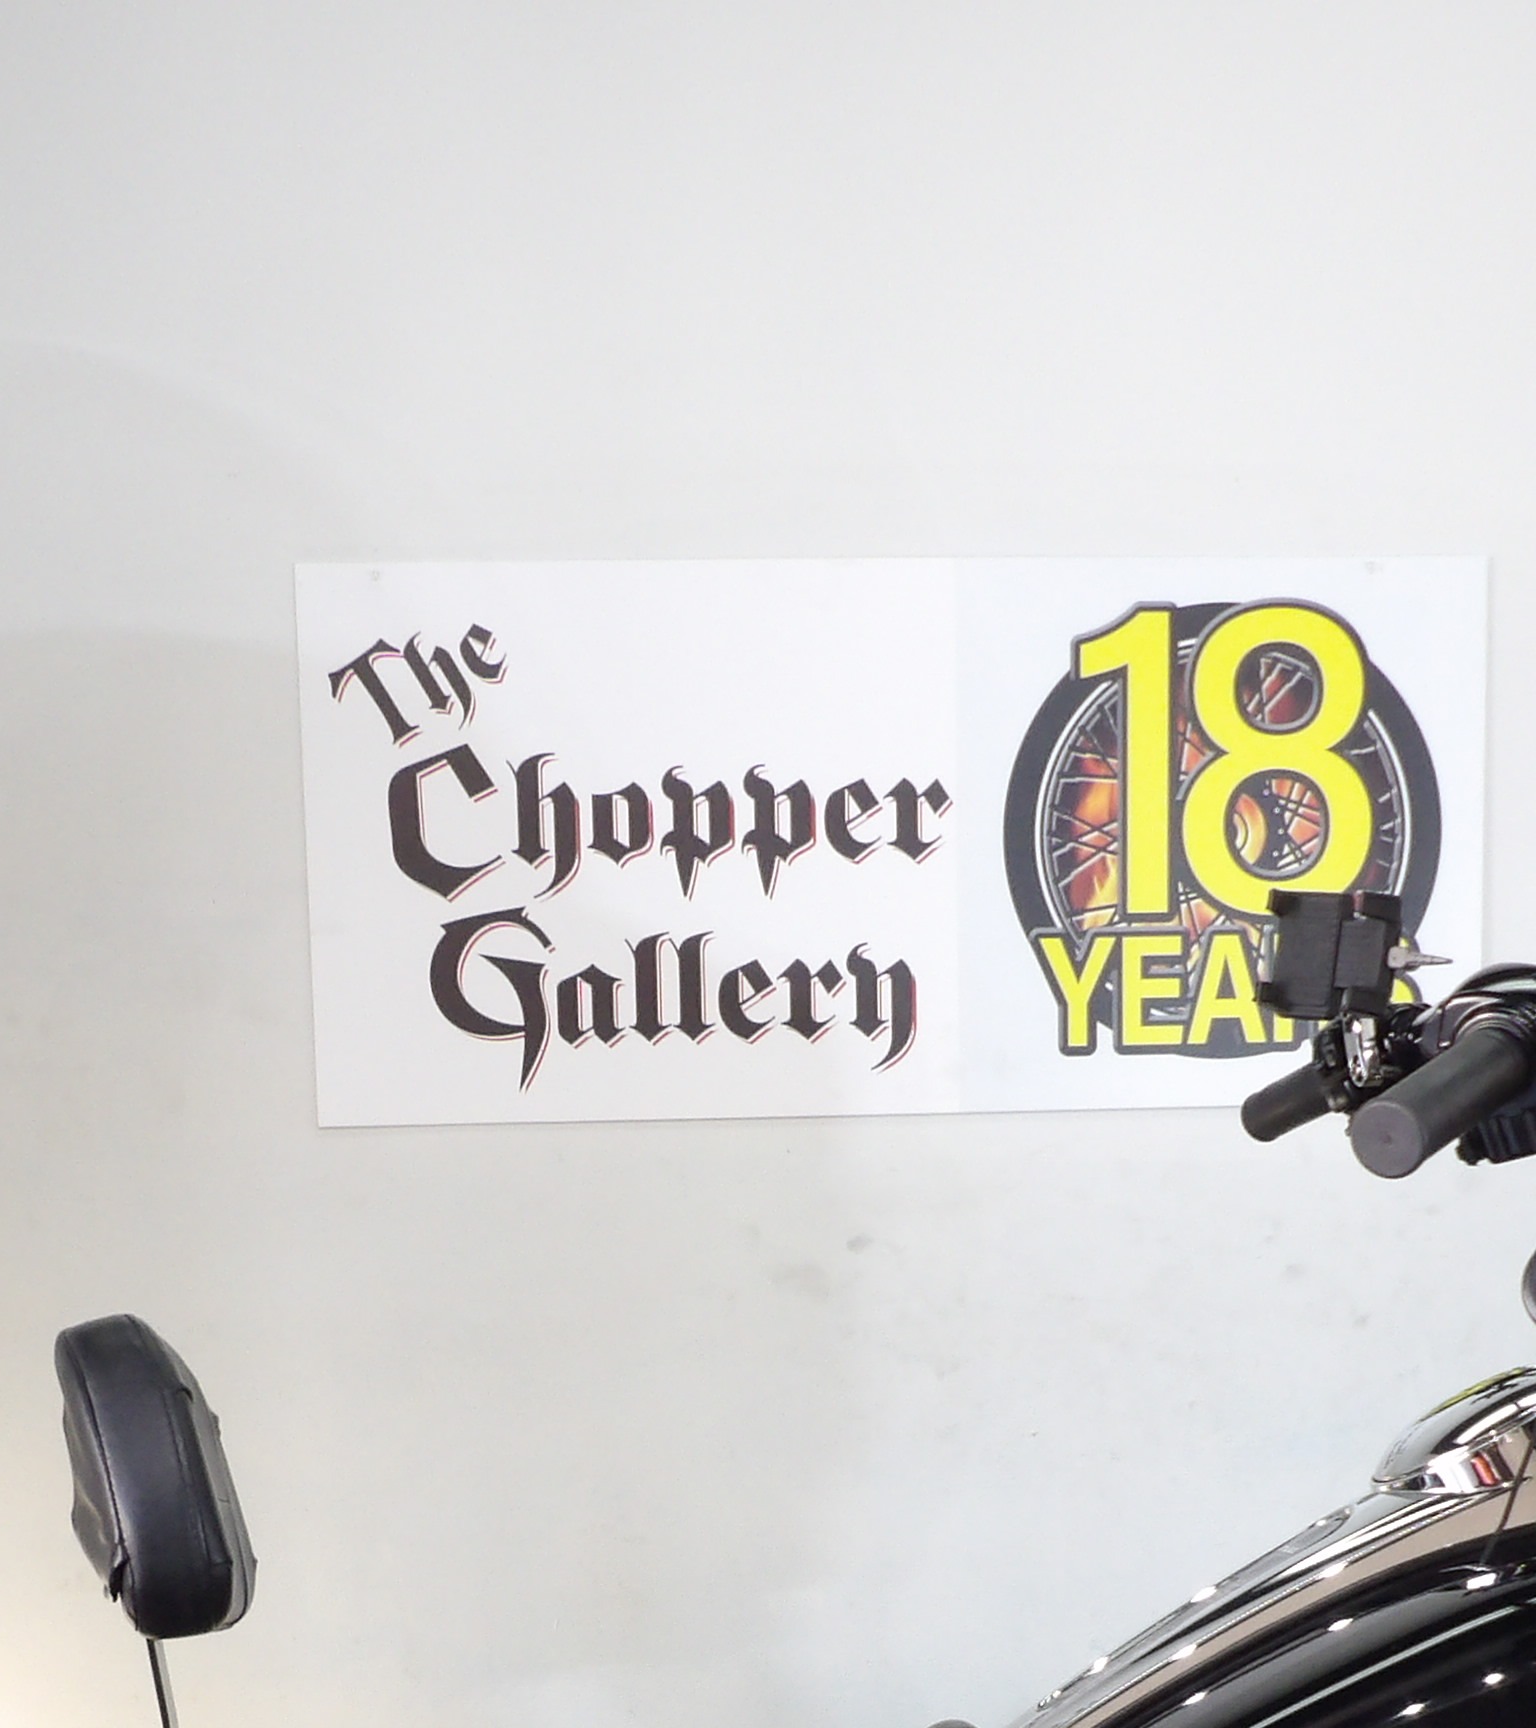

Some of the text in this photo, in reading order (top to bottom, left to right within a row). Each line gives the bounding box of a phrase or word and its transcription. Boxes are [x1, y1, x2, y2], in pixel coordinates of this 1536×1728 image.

[328, 621, 508, 744] The
[1074, 602, 1372, 918] 18
[387, 743, 954, 902] Chopper
[427, 907, 918, 1093] Gallery
[1039, 932, 1418, 1050] YEA
